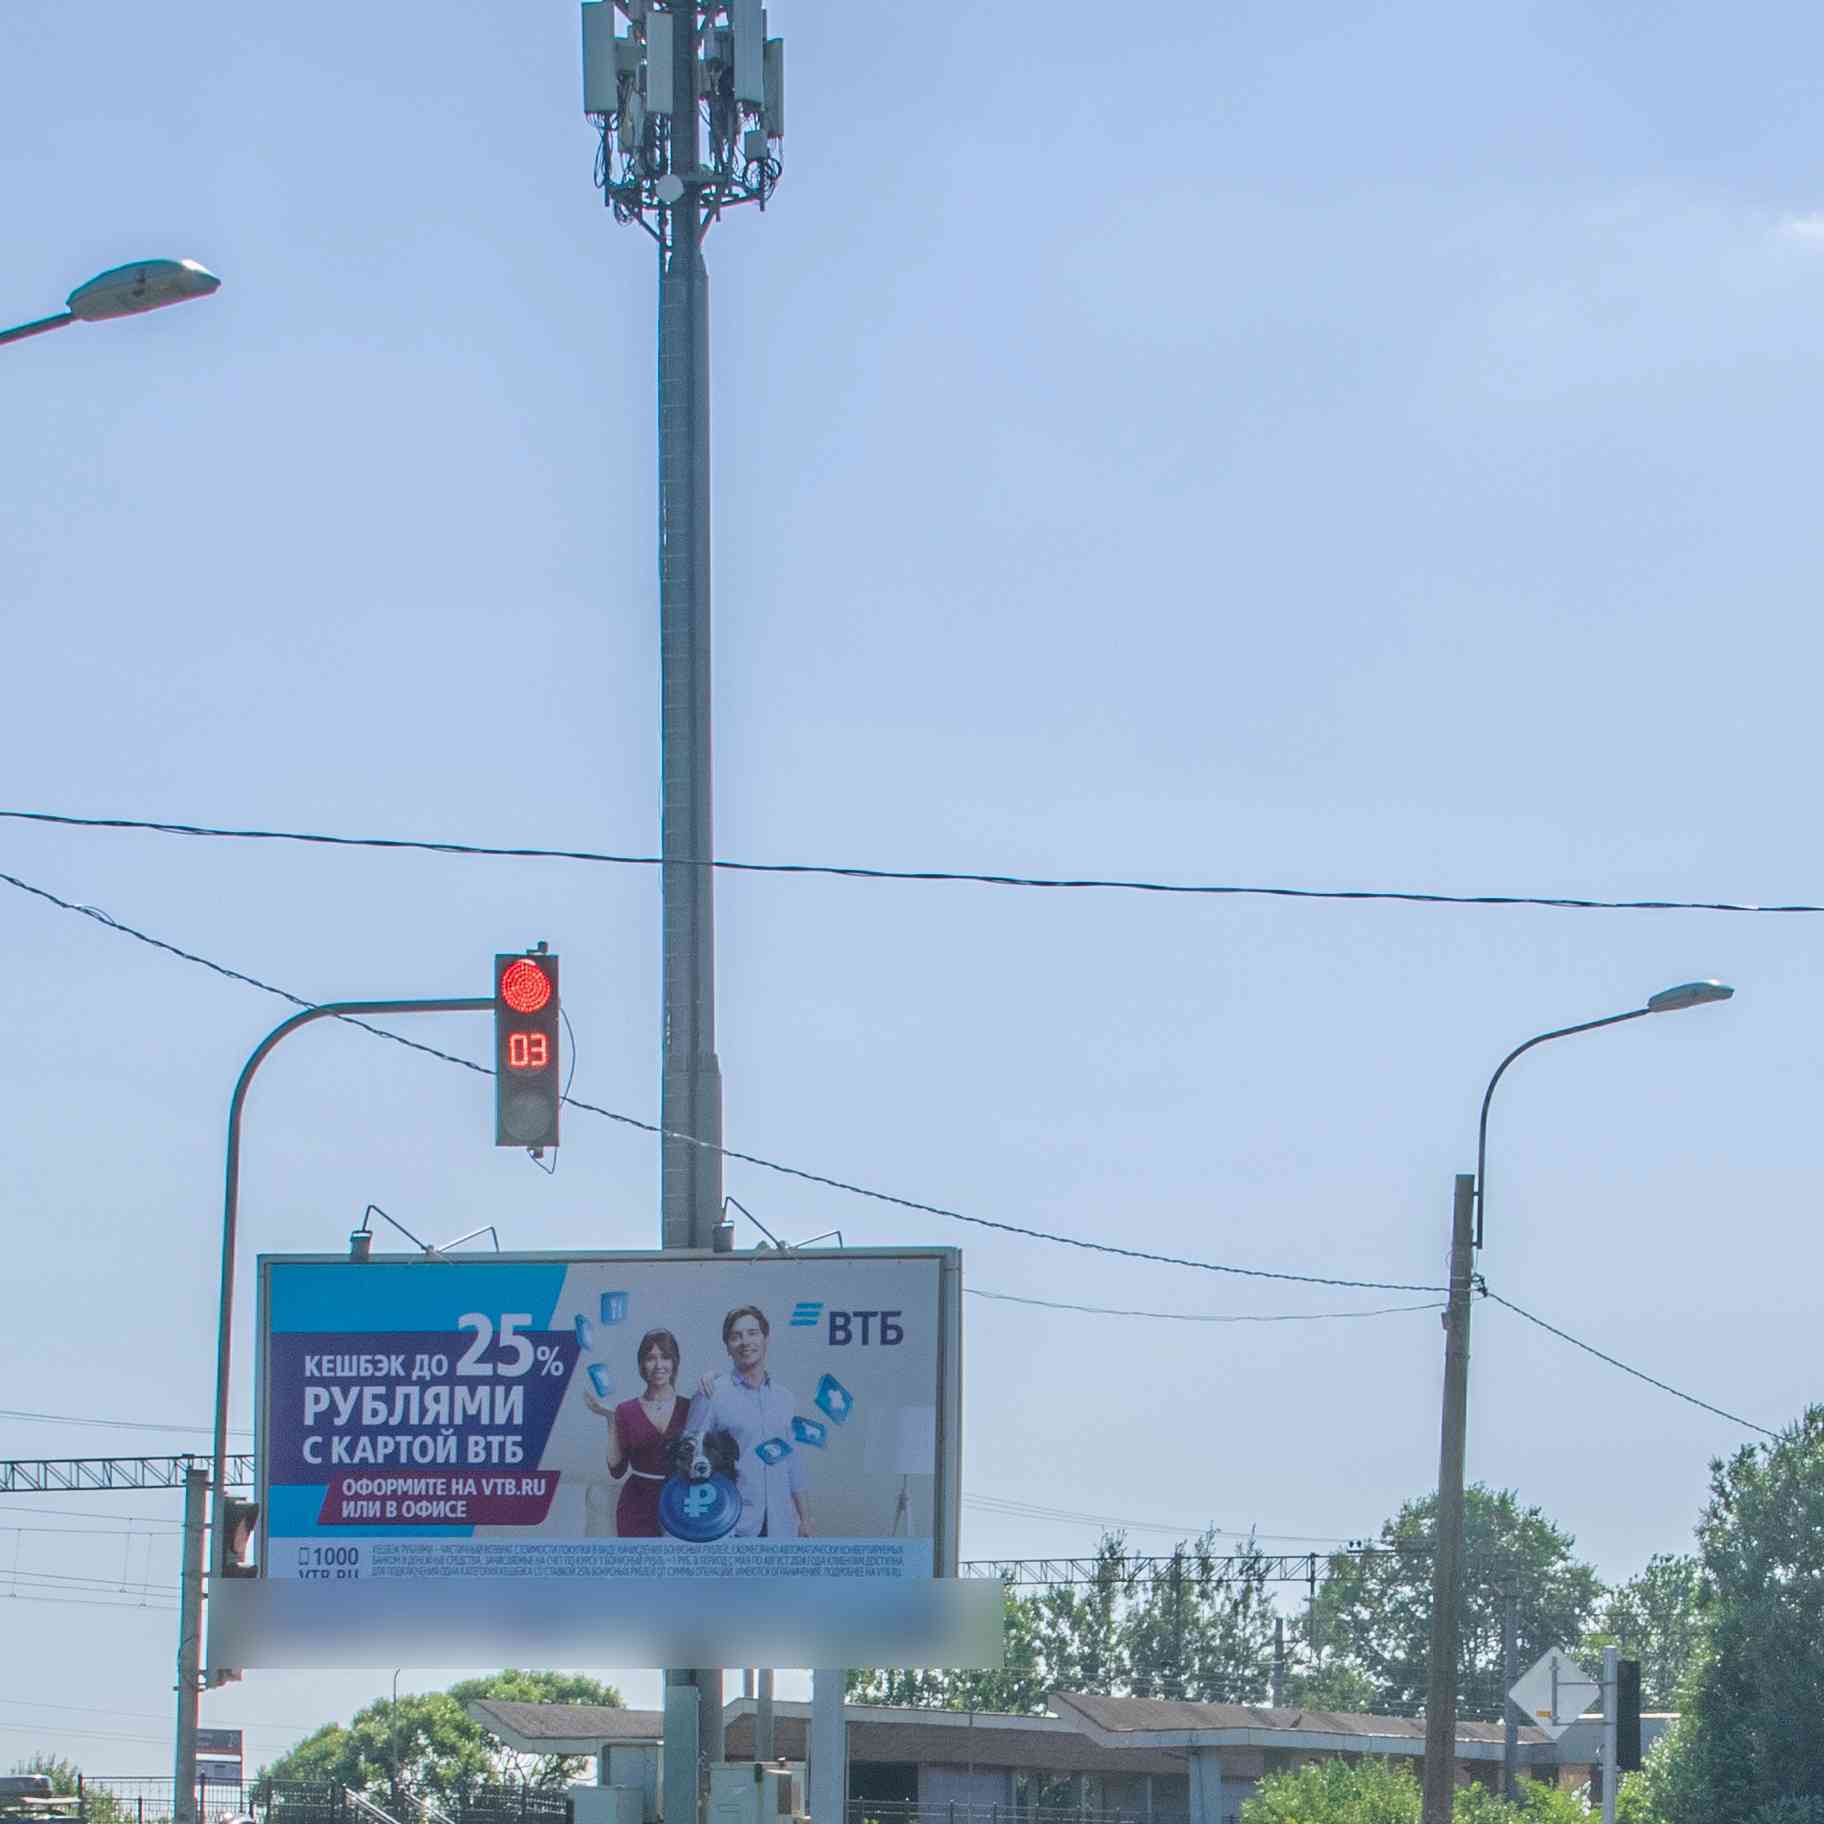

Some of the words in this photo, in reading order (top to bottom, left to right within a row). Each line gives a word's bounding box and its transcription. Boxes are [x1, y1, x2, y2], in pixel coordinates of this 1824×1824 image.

[509, 1033, 548, 1067] 03
[828, 1310, 905, 1346] ВТБ
[304, 1354, 407, 1377] КЕШБЭК
[411, 1354, 448, 1381] ДО
[455, 1311, 565, 1378] 25%
[303, 1385, 525, 1426] РУБЛЯМИ
[303, 1435, 323, 1465] С
[331, 1427, 457, 1465] КАРТОЙ
[467, 1435, 525, 1464] ВТБ
[342, 1477, 447, 1497] ОФОРМИТЕ
[451, 1478, 477, 1496] НА
[481, 1478, 547, 1496] VTB.RU
[341, 1500, 381, 1518] ИЛИ
[385, 1500, 399, 1518] В
[401, 1499, 467, 1519] ОФИСЕ
[314, 1546, 360, 1566] 1000
